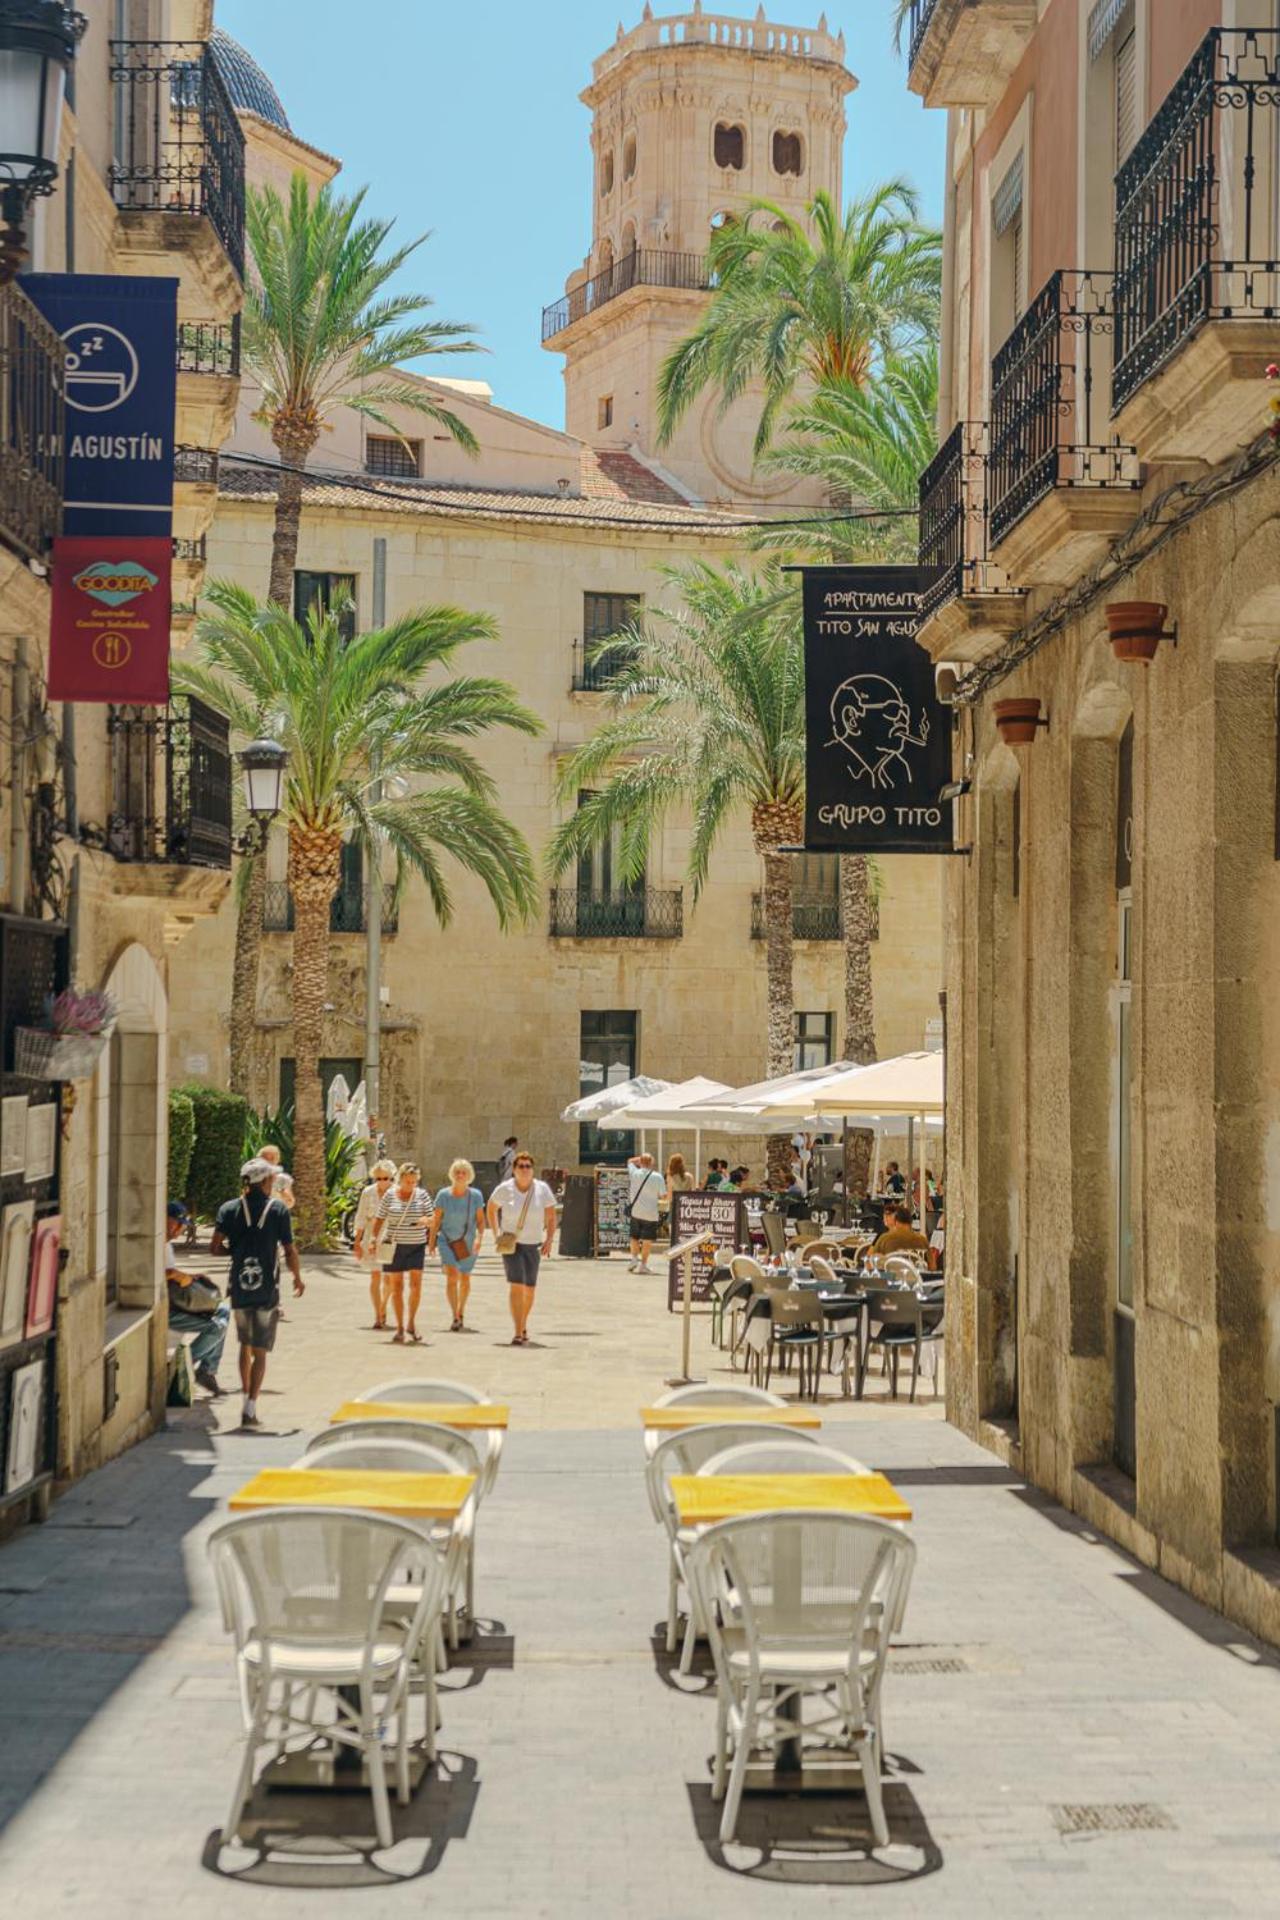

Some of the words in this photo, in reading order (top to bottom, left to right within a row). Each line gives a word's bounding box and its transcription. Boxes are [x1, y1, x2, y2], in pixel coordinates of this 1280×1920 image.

[70, 432, 163, 461] AGUSTÍN
[76, 575, 154, 592] GOODITA
[816, 620, 852, 636] TITO
[854, 618, 880, 638] SAN
[886, 618, 920, 638] AGUS
[818, 803, 886, 830] GRUPO
[893, 806, 942, 827] TITO
